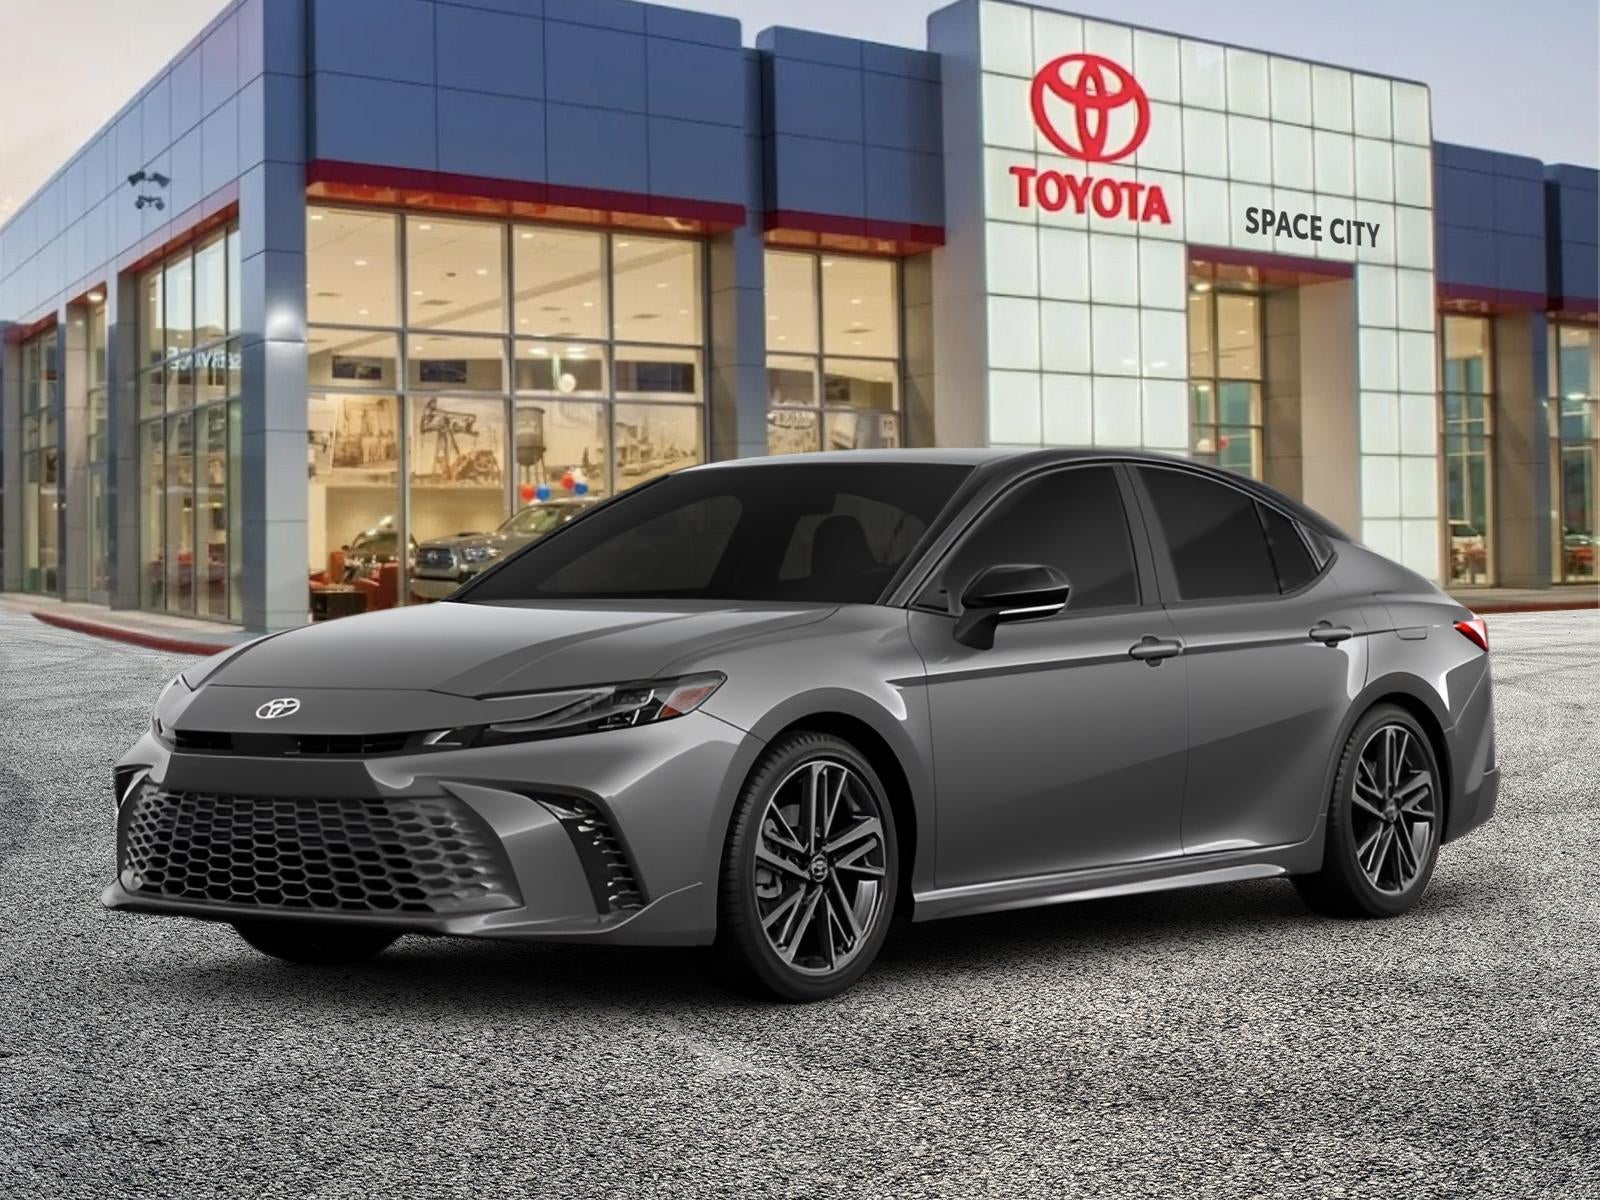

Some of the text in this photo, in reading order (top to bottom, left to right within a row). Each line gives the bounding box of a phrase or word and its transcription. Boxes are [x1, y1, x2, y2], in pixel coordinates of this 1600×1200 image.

[1010, 167, 1171, 224] TOYOTA
[1245, 207, 1380, 248] SPACE CITY
